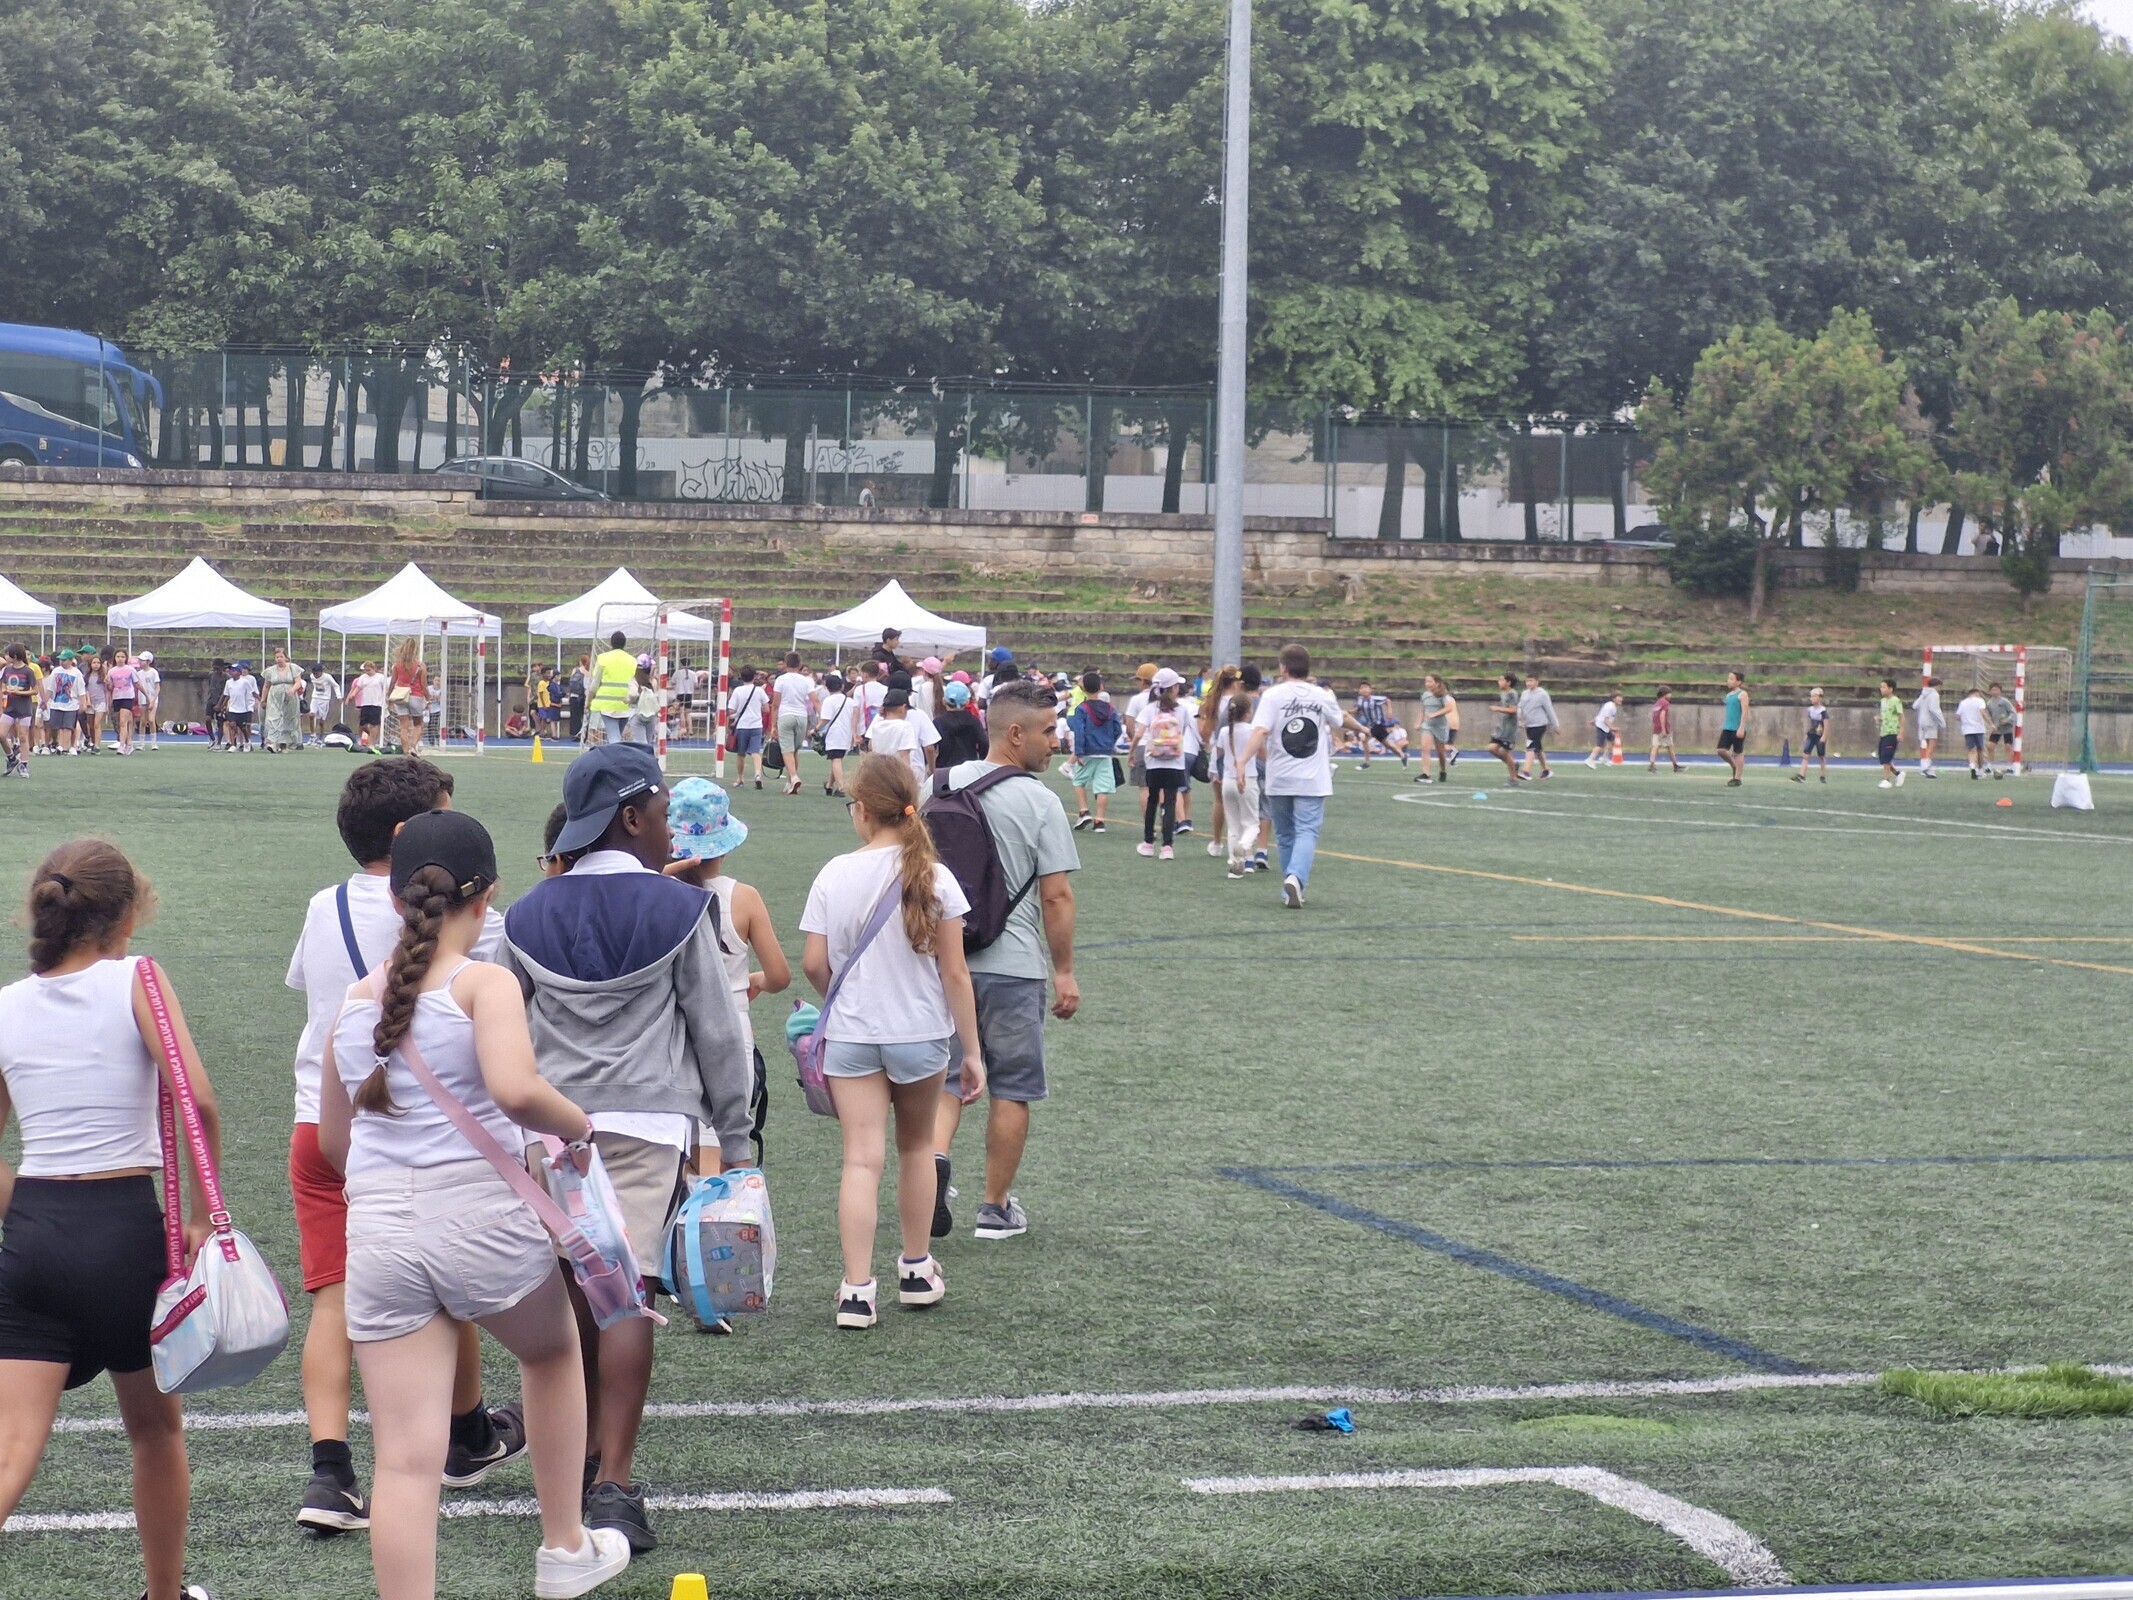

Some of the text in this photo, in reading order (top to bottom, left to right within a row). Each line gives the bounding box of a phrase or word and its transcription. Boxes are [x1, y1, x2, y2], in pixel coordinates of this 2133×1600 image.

[145, 981, 164, 1010] LULUCA
[157, 1018, 176, 1049] LULUCA
[169, 1056, 187, 1088] LULUCA
[162, 1104, 174, 1138] LULUCA
[181, 1096, 199, 1129] LULUCA
[164, 1148, 177, 1182] LULUCA
[192, 1137, 210, 1169] LULUCA
[167, 1191, 179, 1225] LULUCA
[204, 1178, 222, 1210] LULUCA
[169, 1236, 181, 1270] LULUCA
